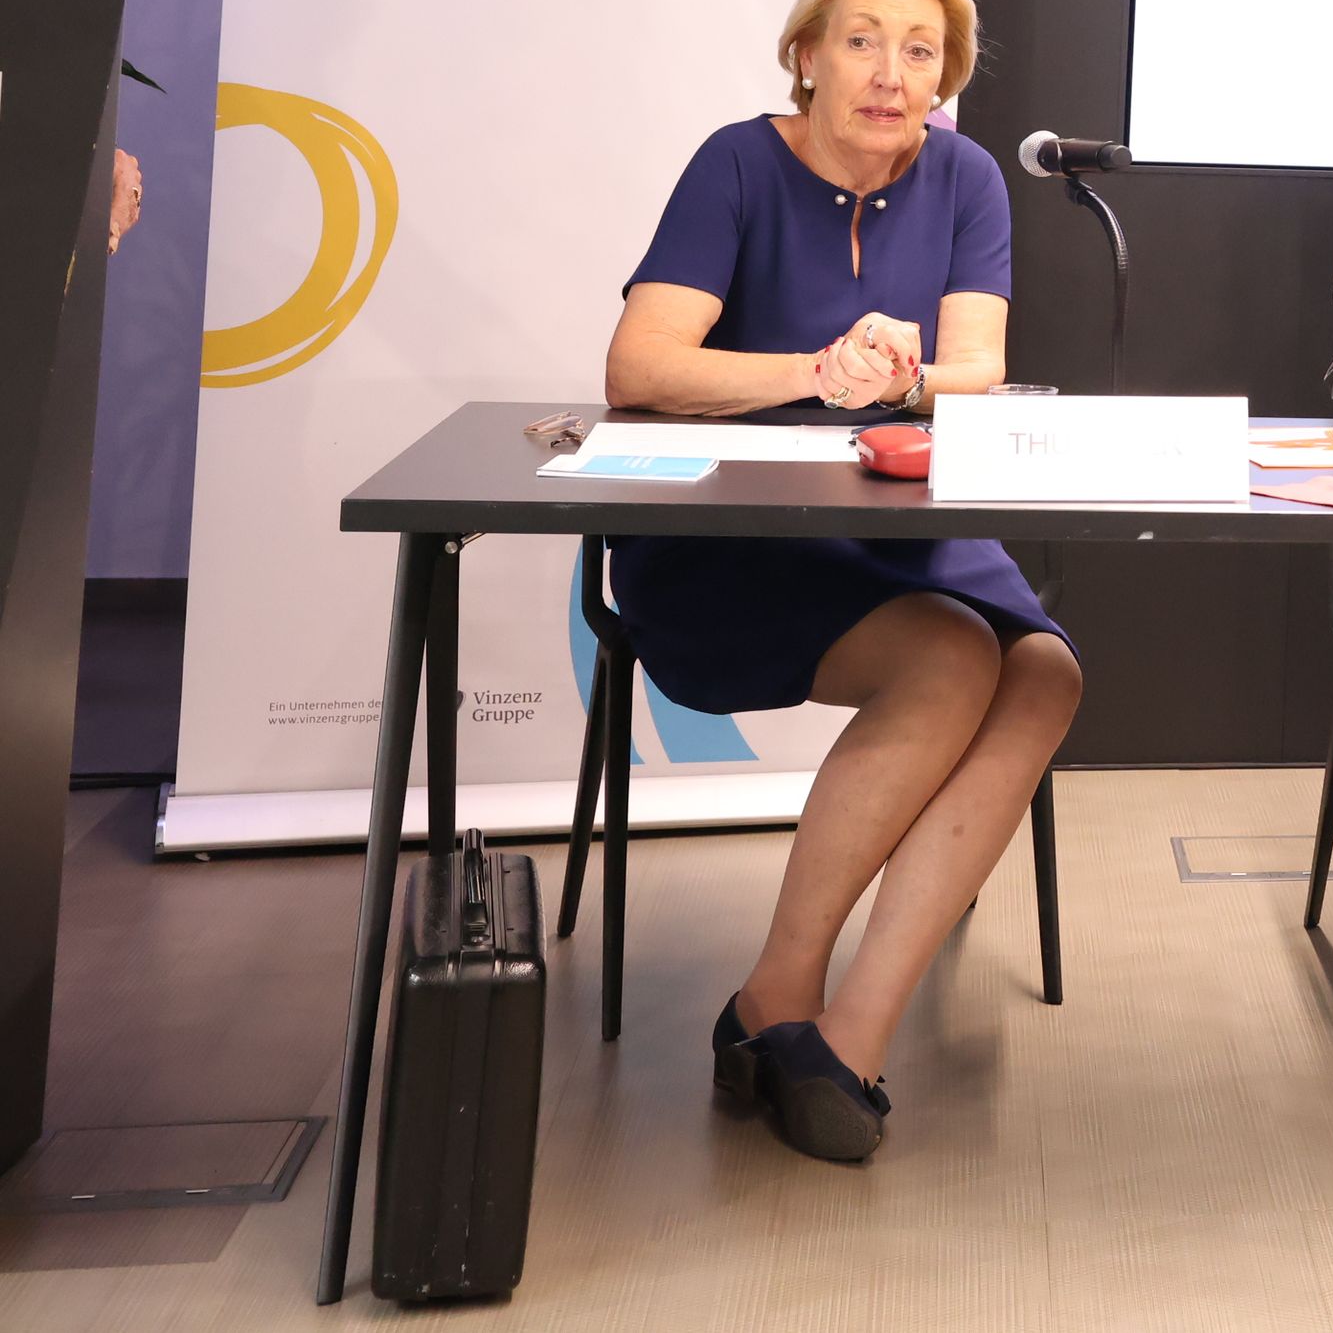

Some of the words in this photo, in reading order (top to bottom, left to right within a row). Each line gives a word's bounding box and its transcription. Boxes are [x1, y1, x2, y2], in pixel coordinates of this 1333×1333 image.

[473, 690, 543, 706] Vinzenz
[269, 702, 285, 711] Ein
[289, 700, 365, 711] Unternehmen
[368, 700, 383, 709] de
[268, 714, 380, 726] www.vinzenzgruppe
[472, 708, 535, 724] Gruppe
